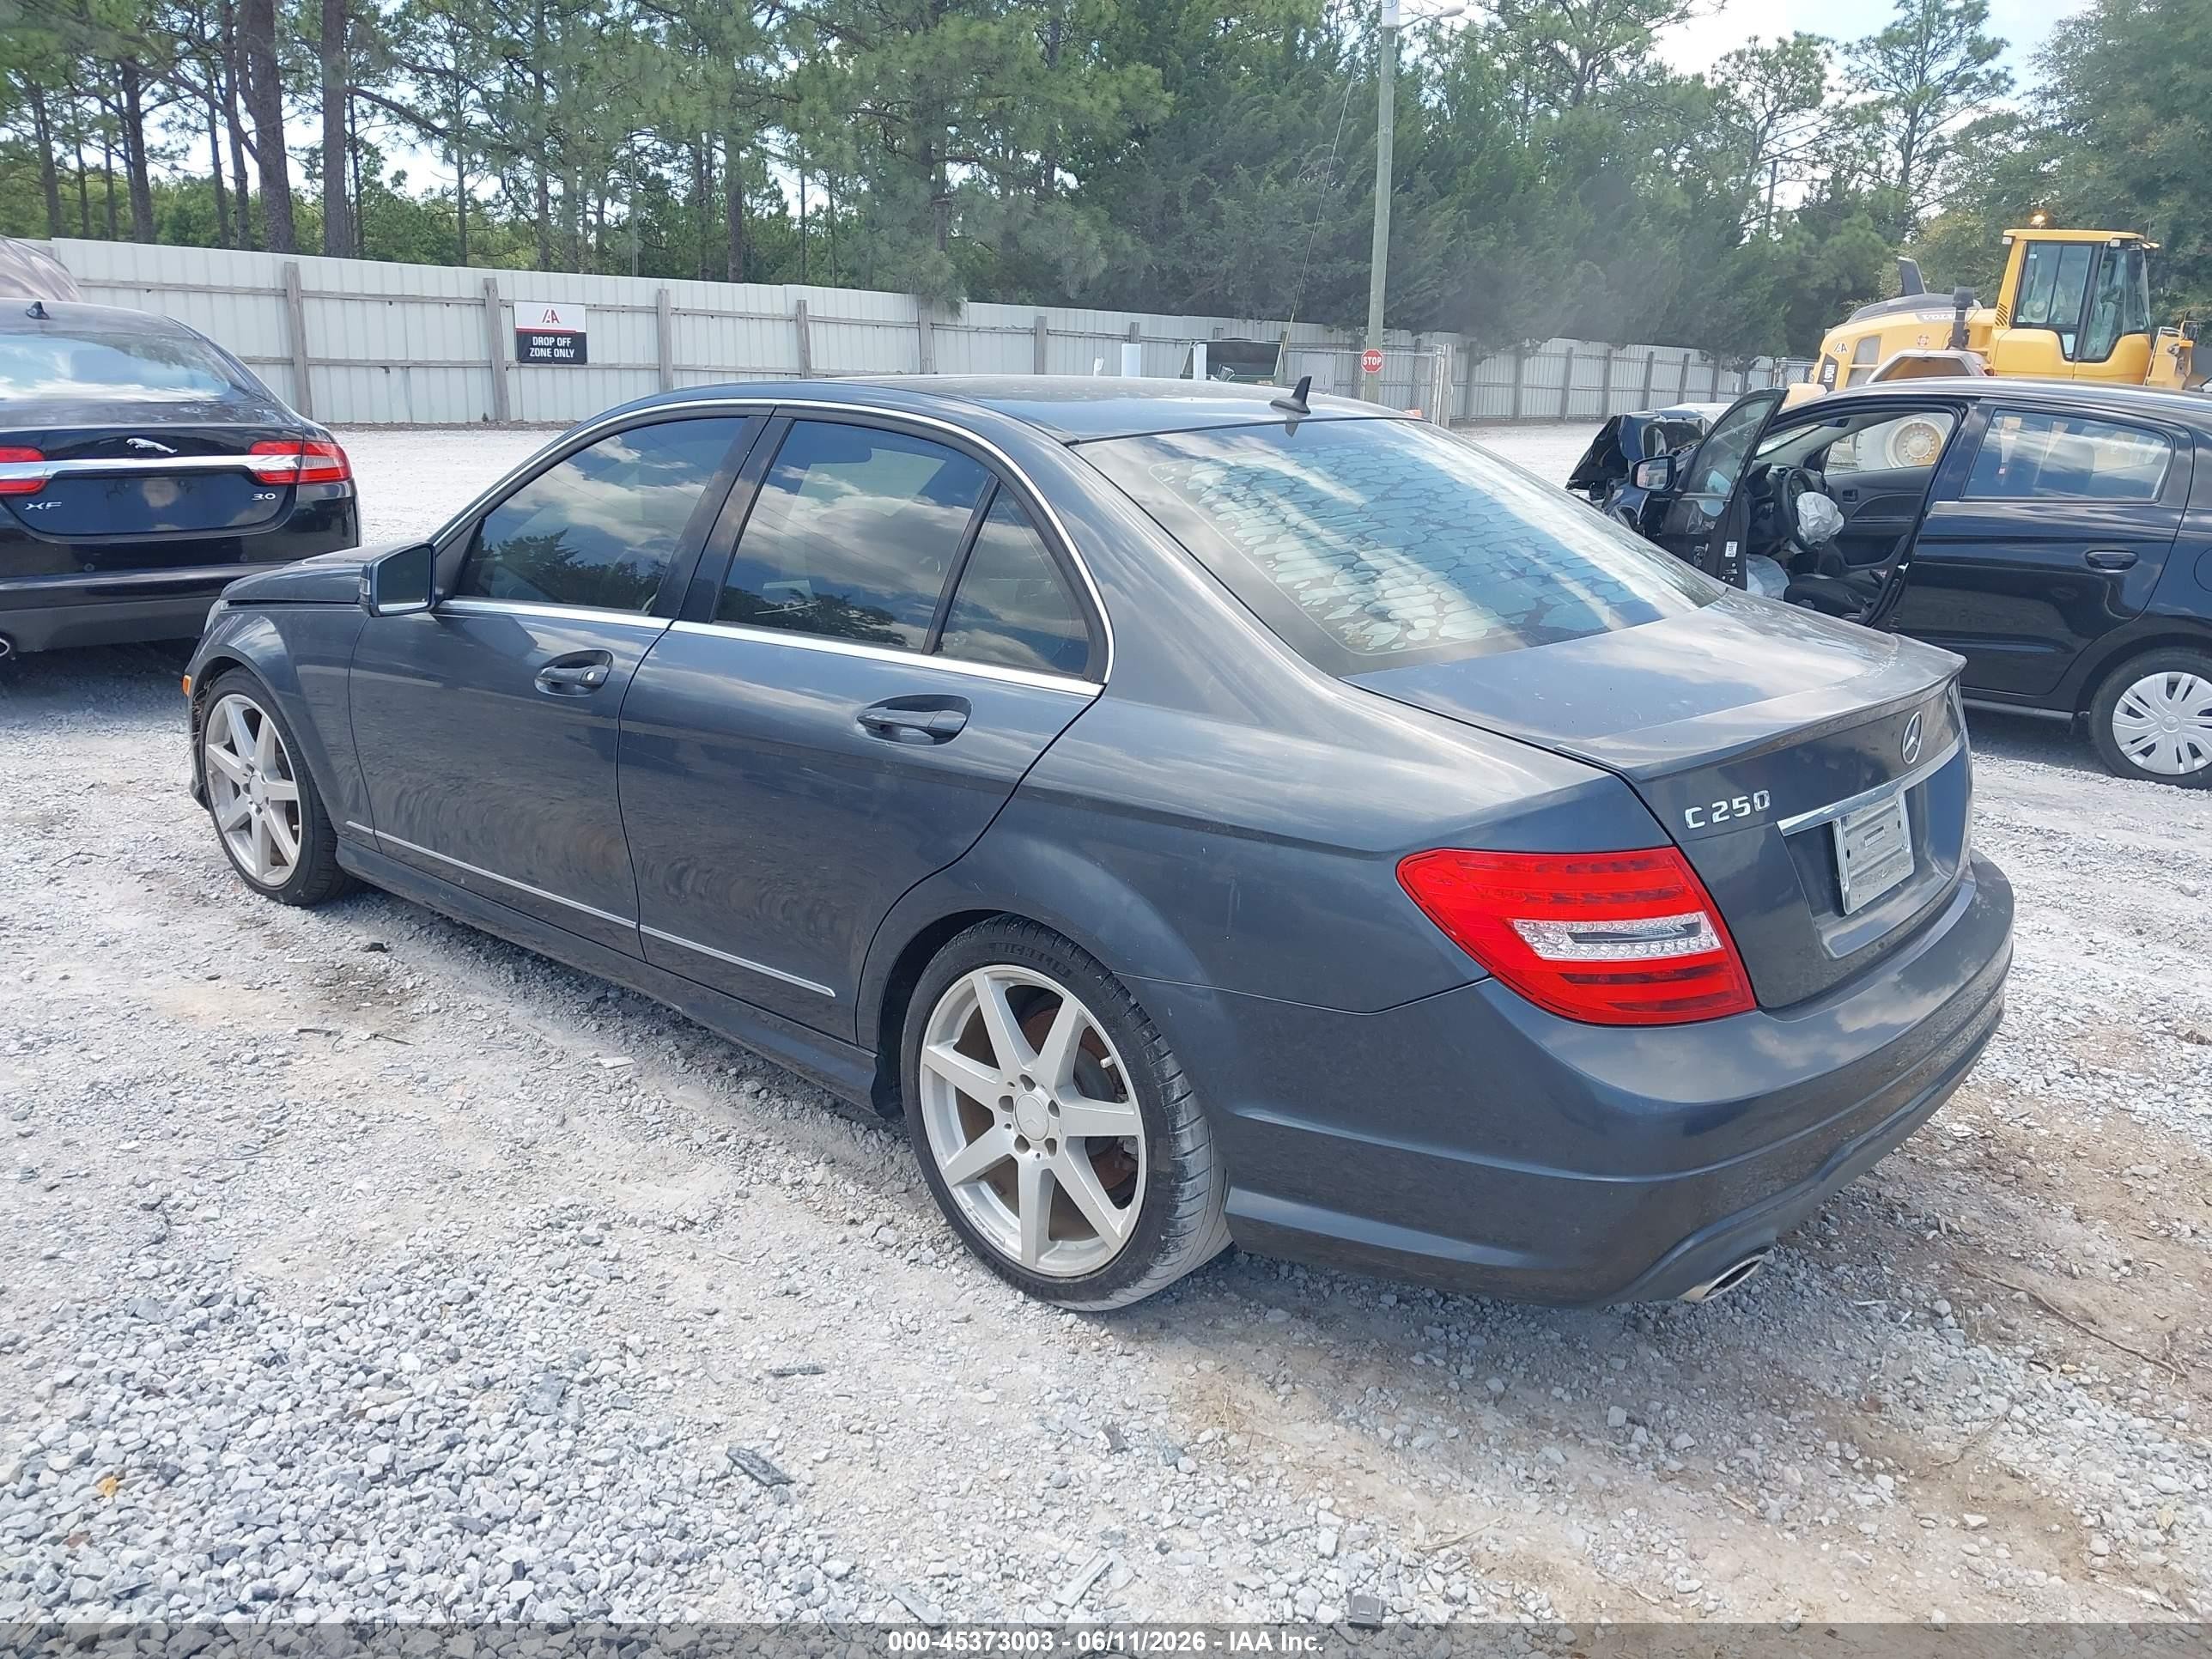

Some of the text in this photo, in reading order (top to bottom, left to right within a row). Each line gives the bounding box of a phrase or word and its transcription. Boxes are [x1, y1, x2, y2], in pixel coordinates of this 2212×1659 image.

[532, 337, 572, 347] DROP OFF
[529, 348, 575, 358] ZONE ONLY
[1363, 356, 1382, 366] STOP
[25, 501, 63, 510] XF
[1685, 790, 1770, 830] C 250
